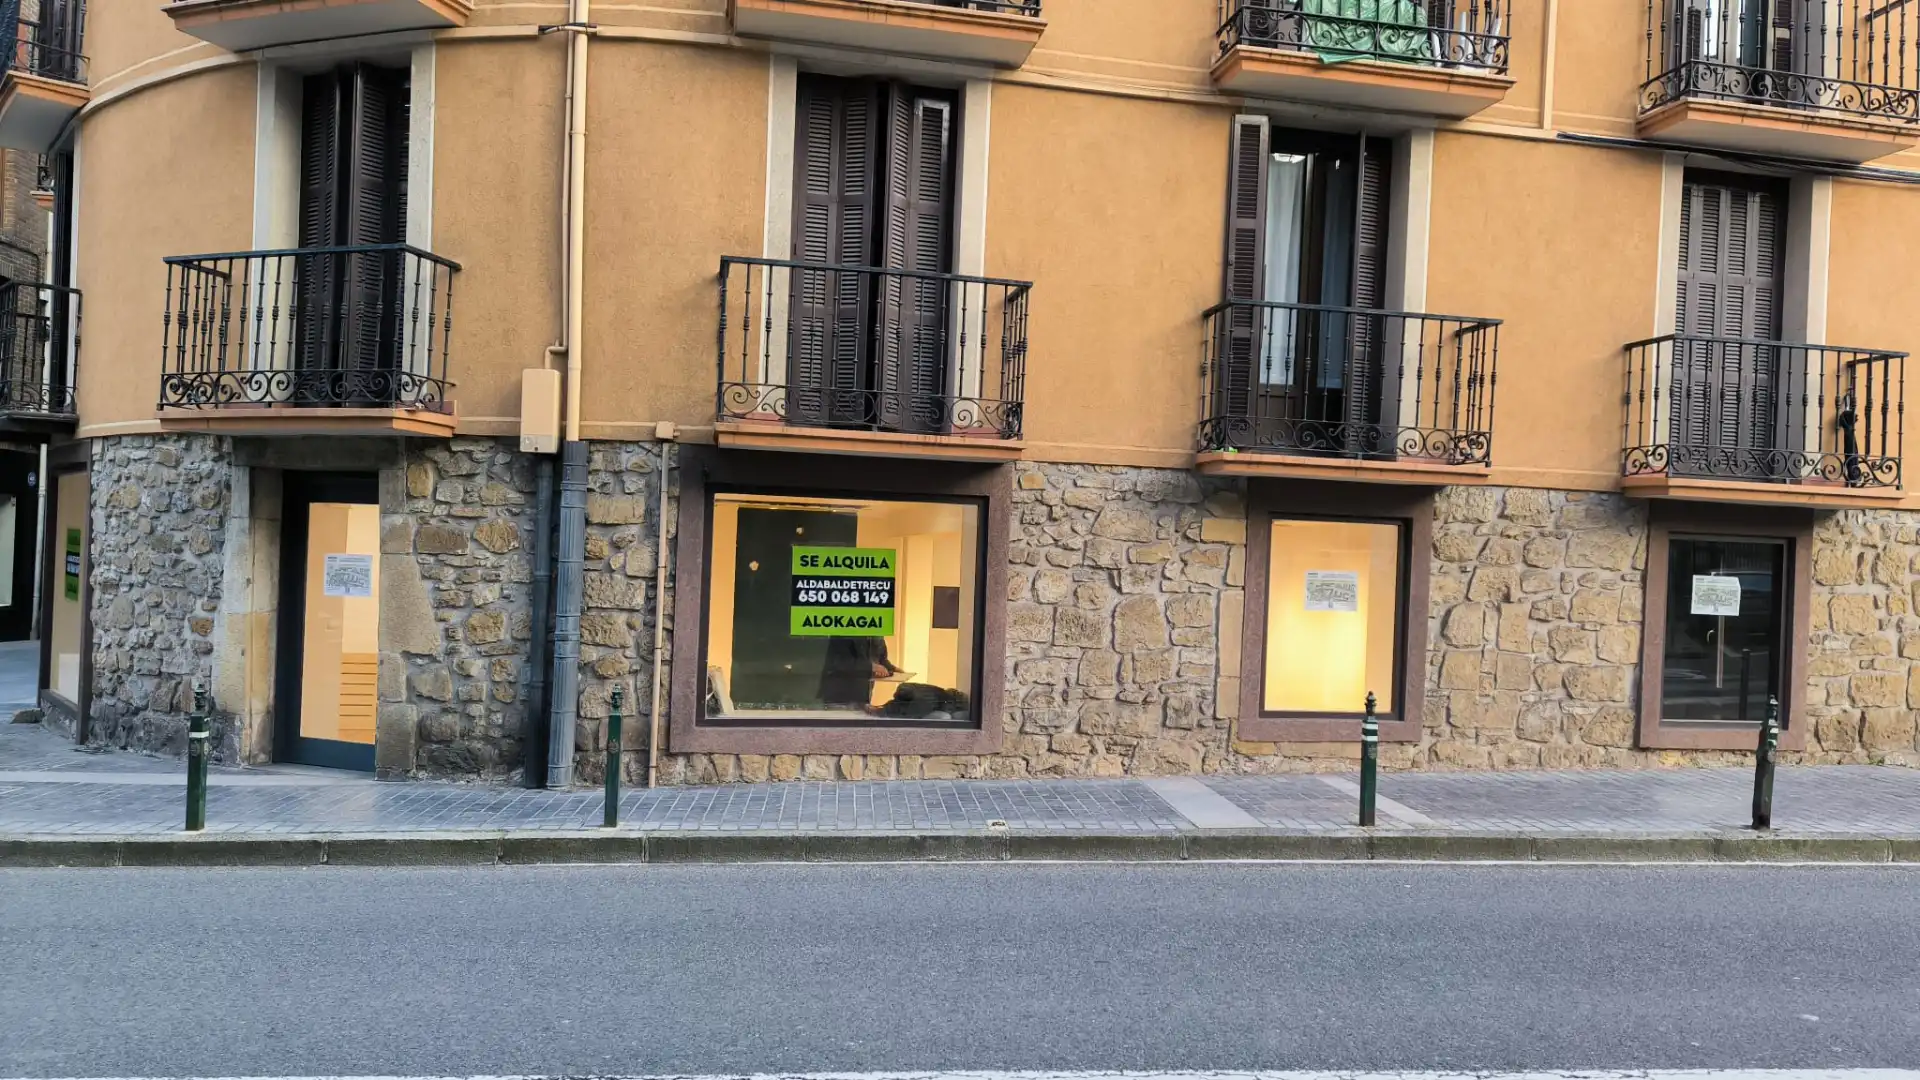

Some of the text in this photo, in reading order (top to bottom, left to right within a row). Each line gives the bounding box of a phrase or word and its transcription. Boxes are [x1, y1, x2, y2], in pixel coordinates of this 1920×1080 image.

[800, 555, 889, 569] SE ALQUILA
[796, 580, 890, 589] ALDABALDETRECU
[798, 591, 889, 604] 650 068 149
[802, 615, 883, 628] ALOKAGAI
